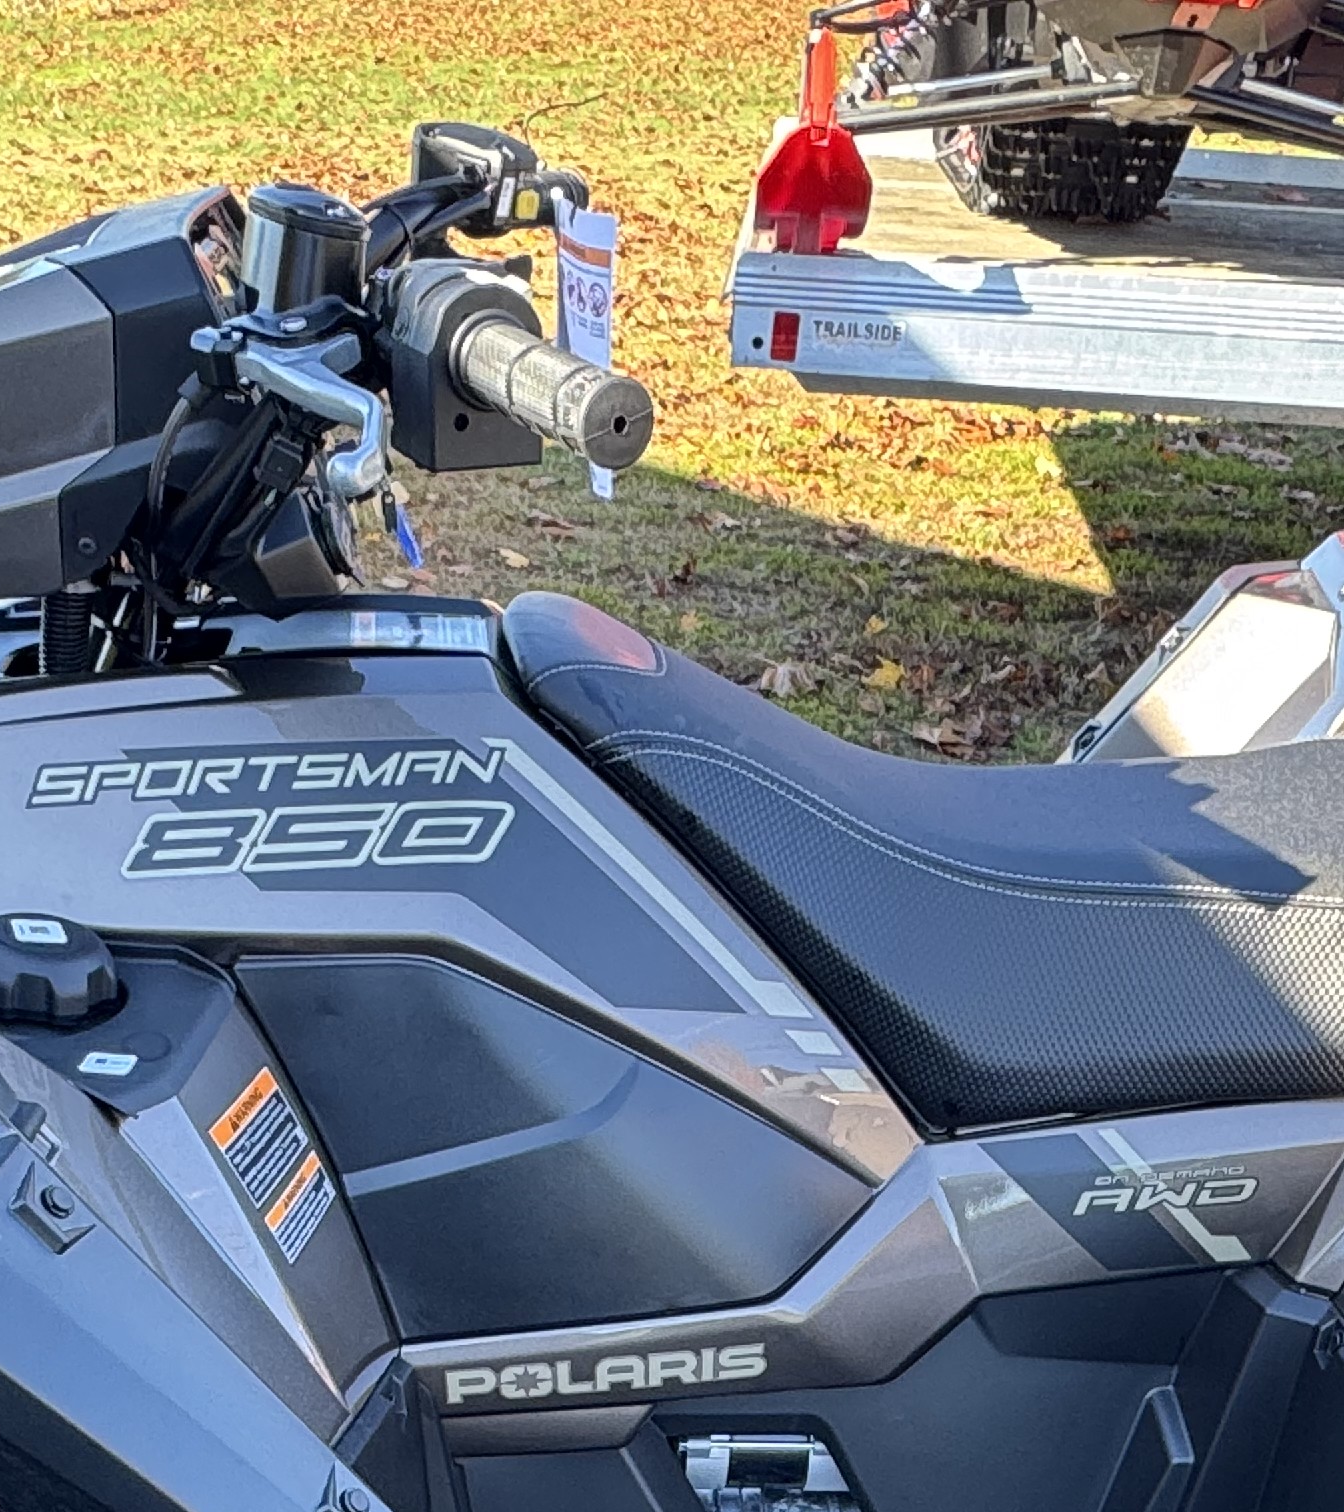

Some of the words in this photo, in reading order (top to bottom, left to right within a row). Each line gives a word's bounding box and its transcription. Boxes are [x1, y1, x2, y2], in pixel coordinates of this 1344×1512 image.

[813, 319, 903, 341] TRAILSIDE
[30, 737, 508, 807] SPORTSMAN
[120, 800, 516, 880] 850
[1072, 1177, 1259, 1217] AWD
[445, 1342, 768, 1405] POLARIS
